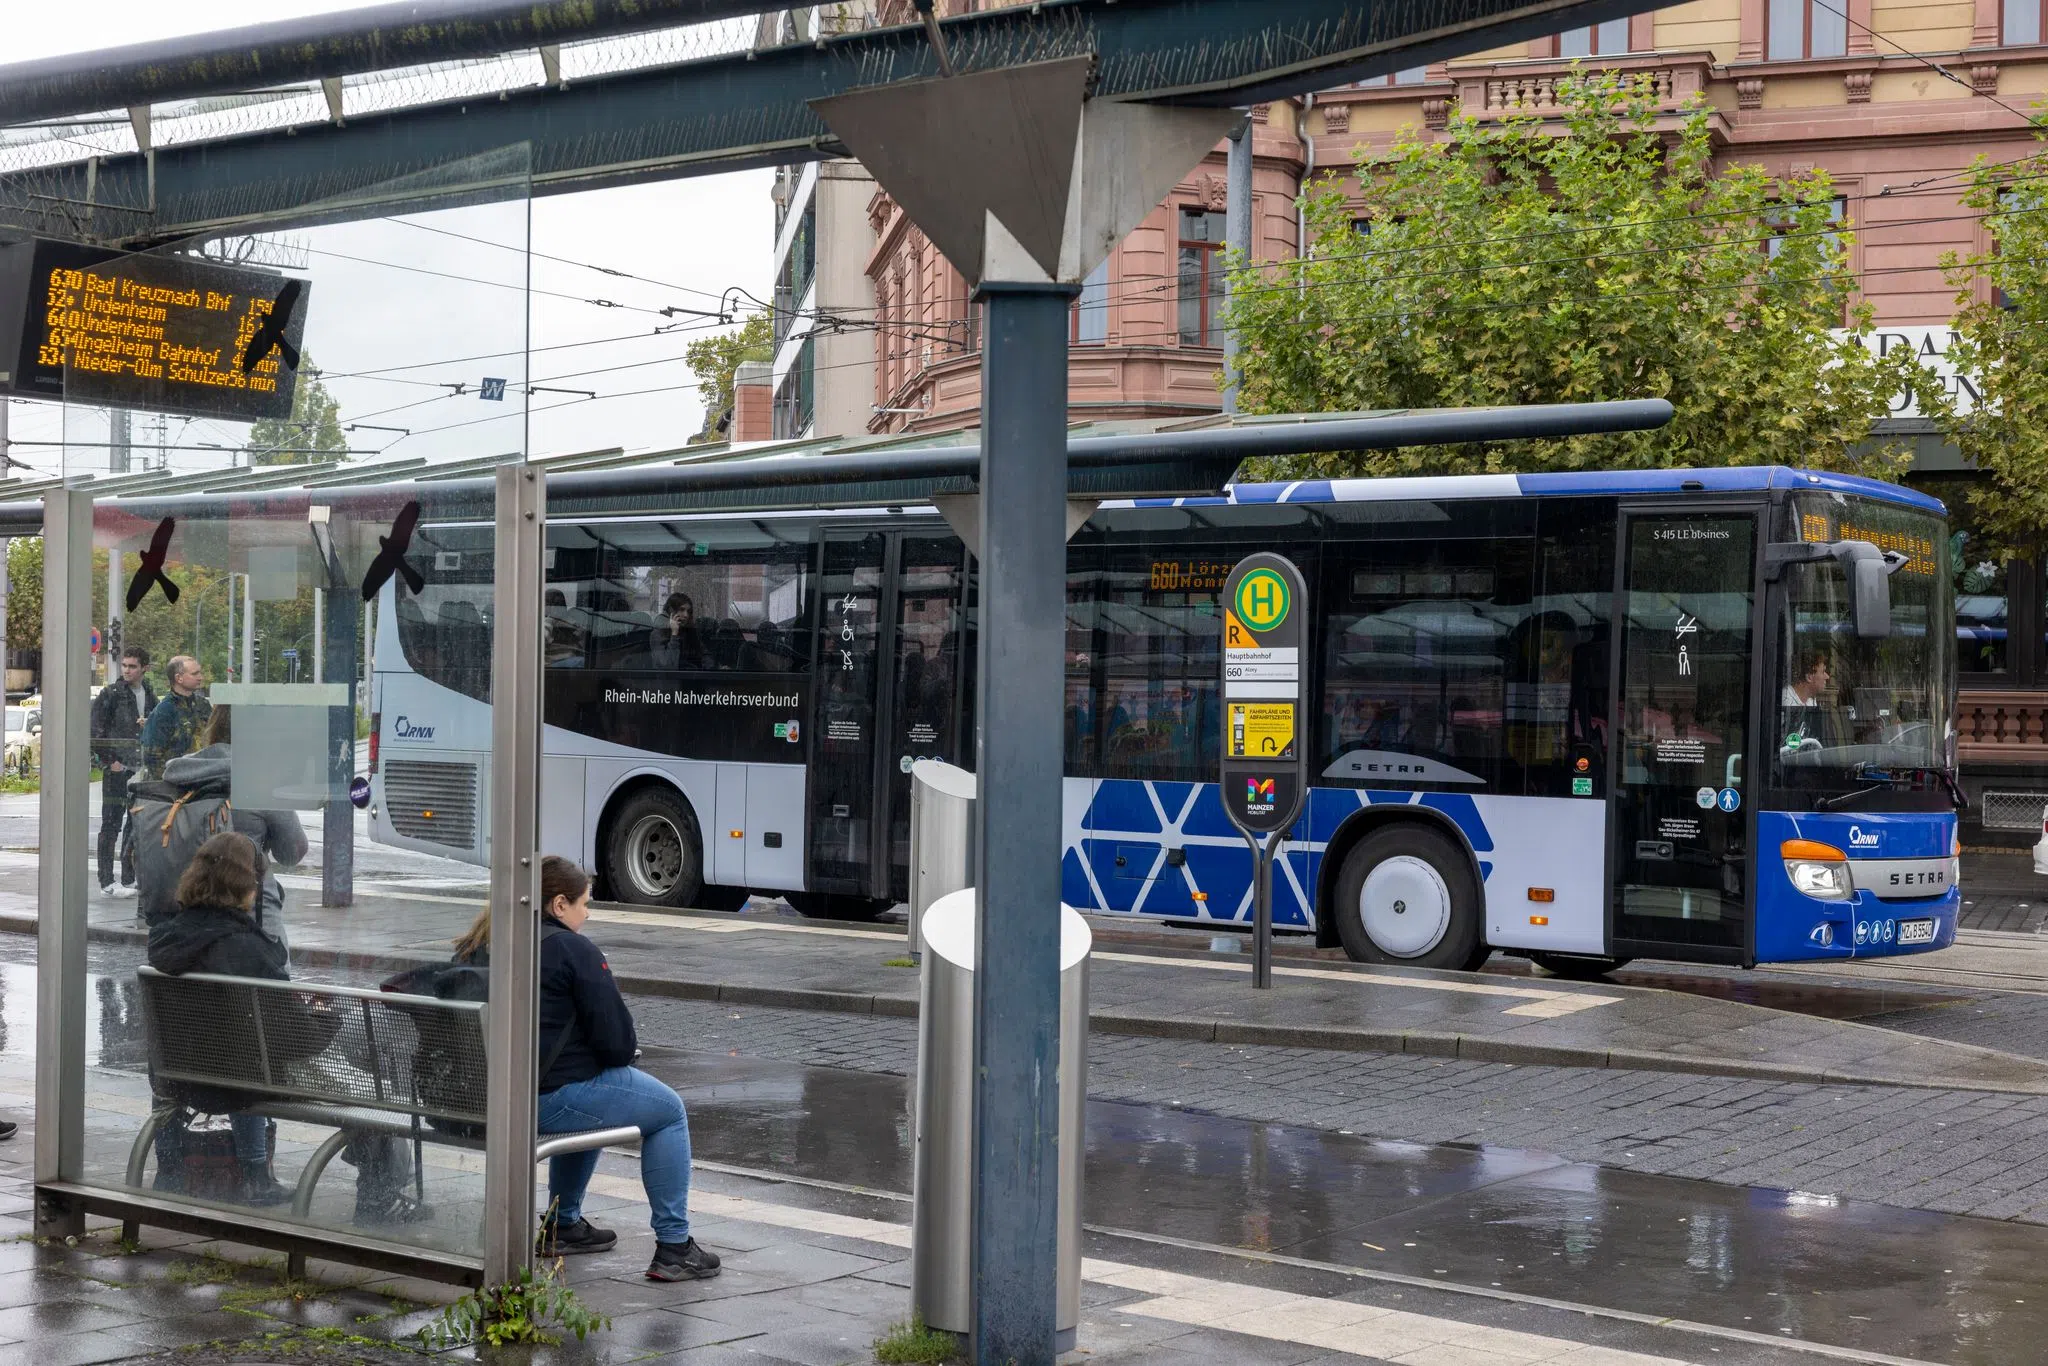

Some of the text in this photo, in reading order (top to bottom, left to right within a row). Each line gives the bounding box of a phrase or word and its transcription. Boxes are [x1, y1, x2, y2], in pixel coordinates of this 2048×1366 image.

[50, 268, 83, 290] 630
[86, 272, 117, 296] Bad
[121, 278, 200, 307] Kreuznach
[206, 291, 232, 311] Bhf
[83, 293, 168, 321] Undenheim
[80, 311, 165, 340] Undenheim
[74, 331, 155, 358] Ingelheim
[159, 341, 222, 367] Bahnhof
[73, 350, 164, 379] Nieder-Olm
[248, 373, 277, 392] min
[1661, 529, 1675, 540] 415
[1677, 529, 1689, 540] LE
[1149, 561, 1232, 590] 660 Lörz
[1251, 582, 1274, 617] H
[1229, 625, 1240, 644] R
[1227, 652, 1272, 661] Hauptbahnhof
[1226, 667, 1242, 677] 660
[604, 690, 799, 708] Rhein-Nahe Nahverkehrsverbund
[408, 726, 435, 738] RNN
[1351, 763, 1425, 774] SETRA
[1859, 834, 1879, 845] RNN
[1890, 871, 1943, 886] SETRA
